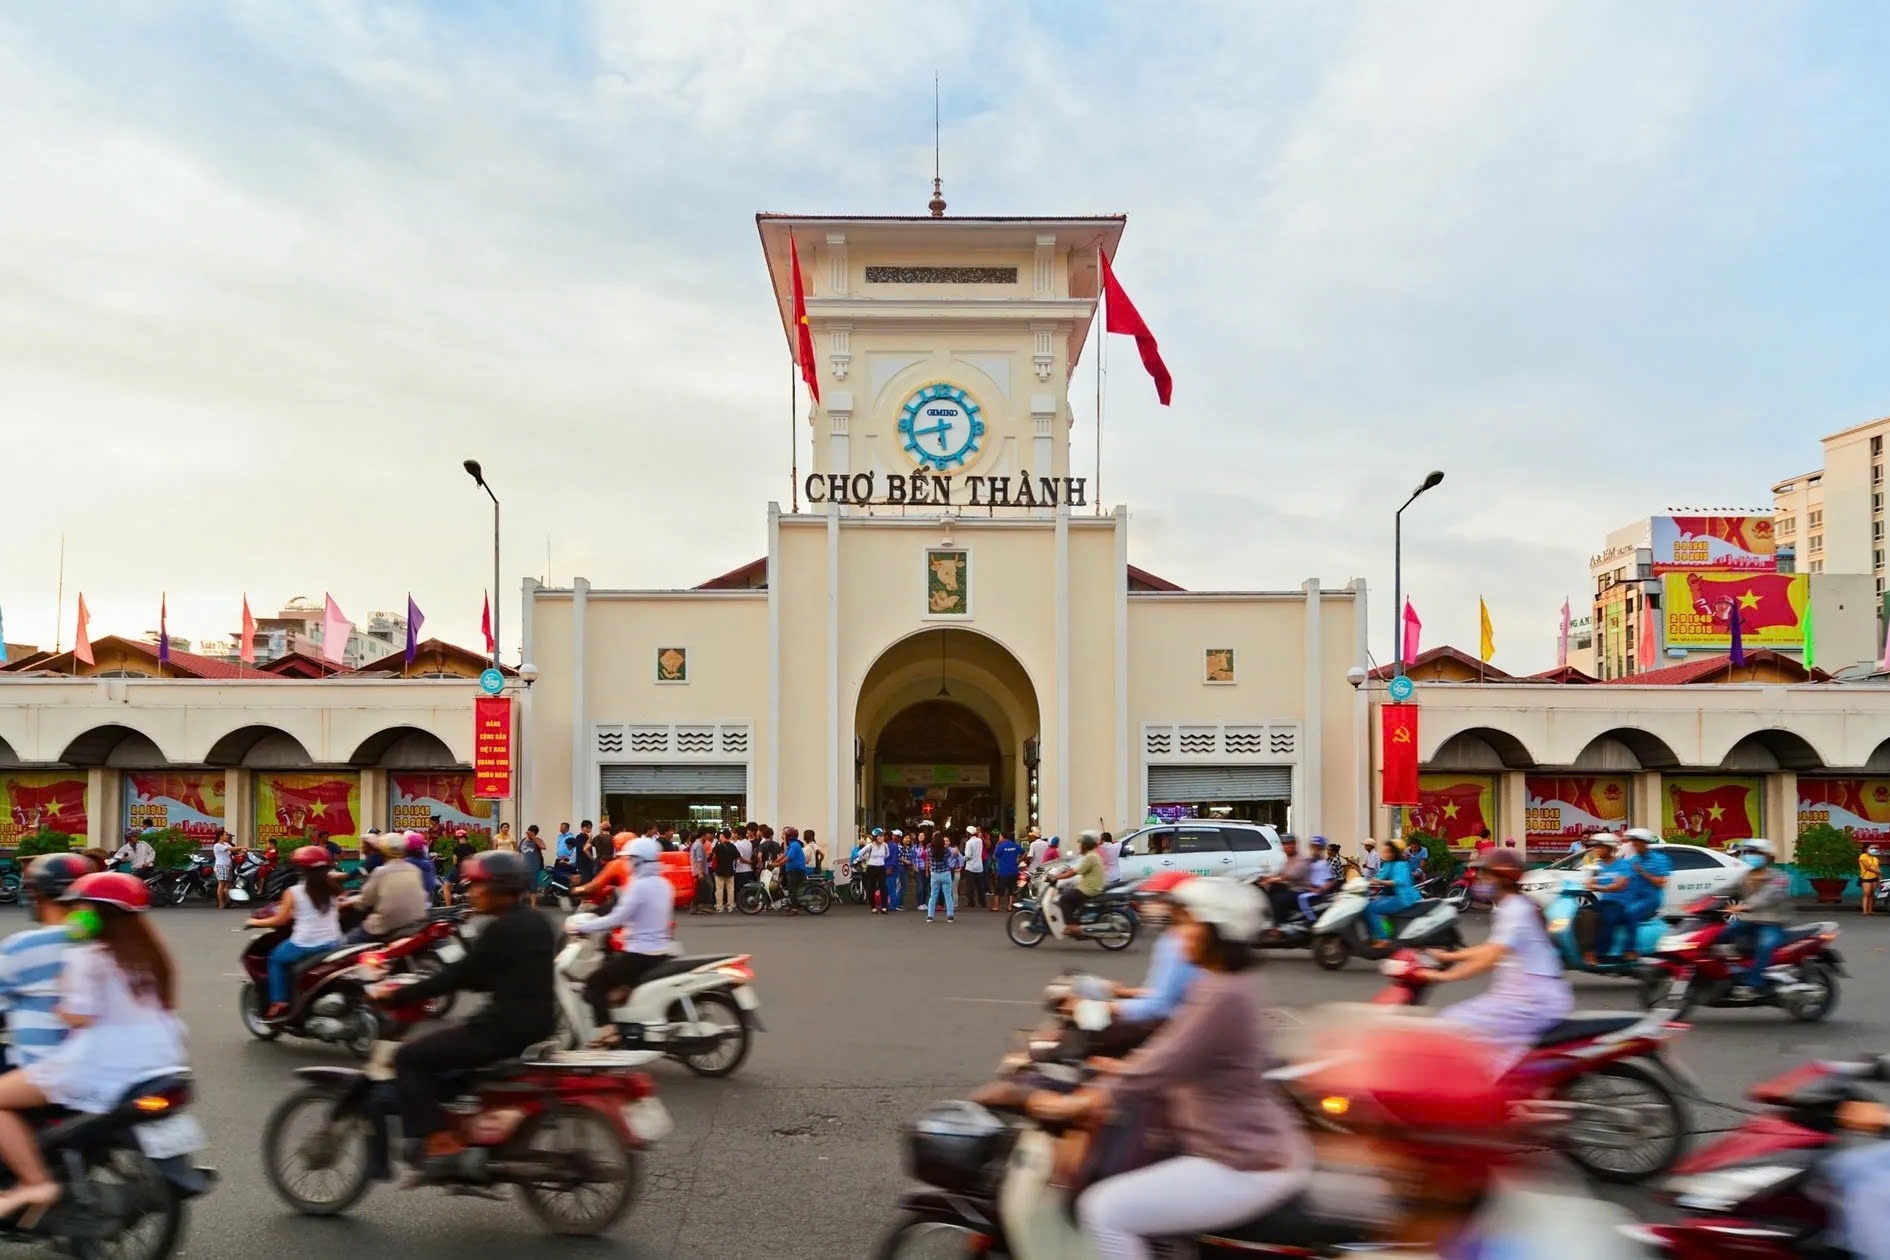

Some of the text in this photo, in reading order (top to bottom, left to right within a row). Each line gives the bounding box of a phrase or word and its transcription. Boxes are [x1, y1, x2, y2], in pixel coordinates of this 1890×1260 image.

[805, 465, 1087, 508] CHỢ BẾN THÀNH
